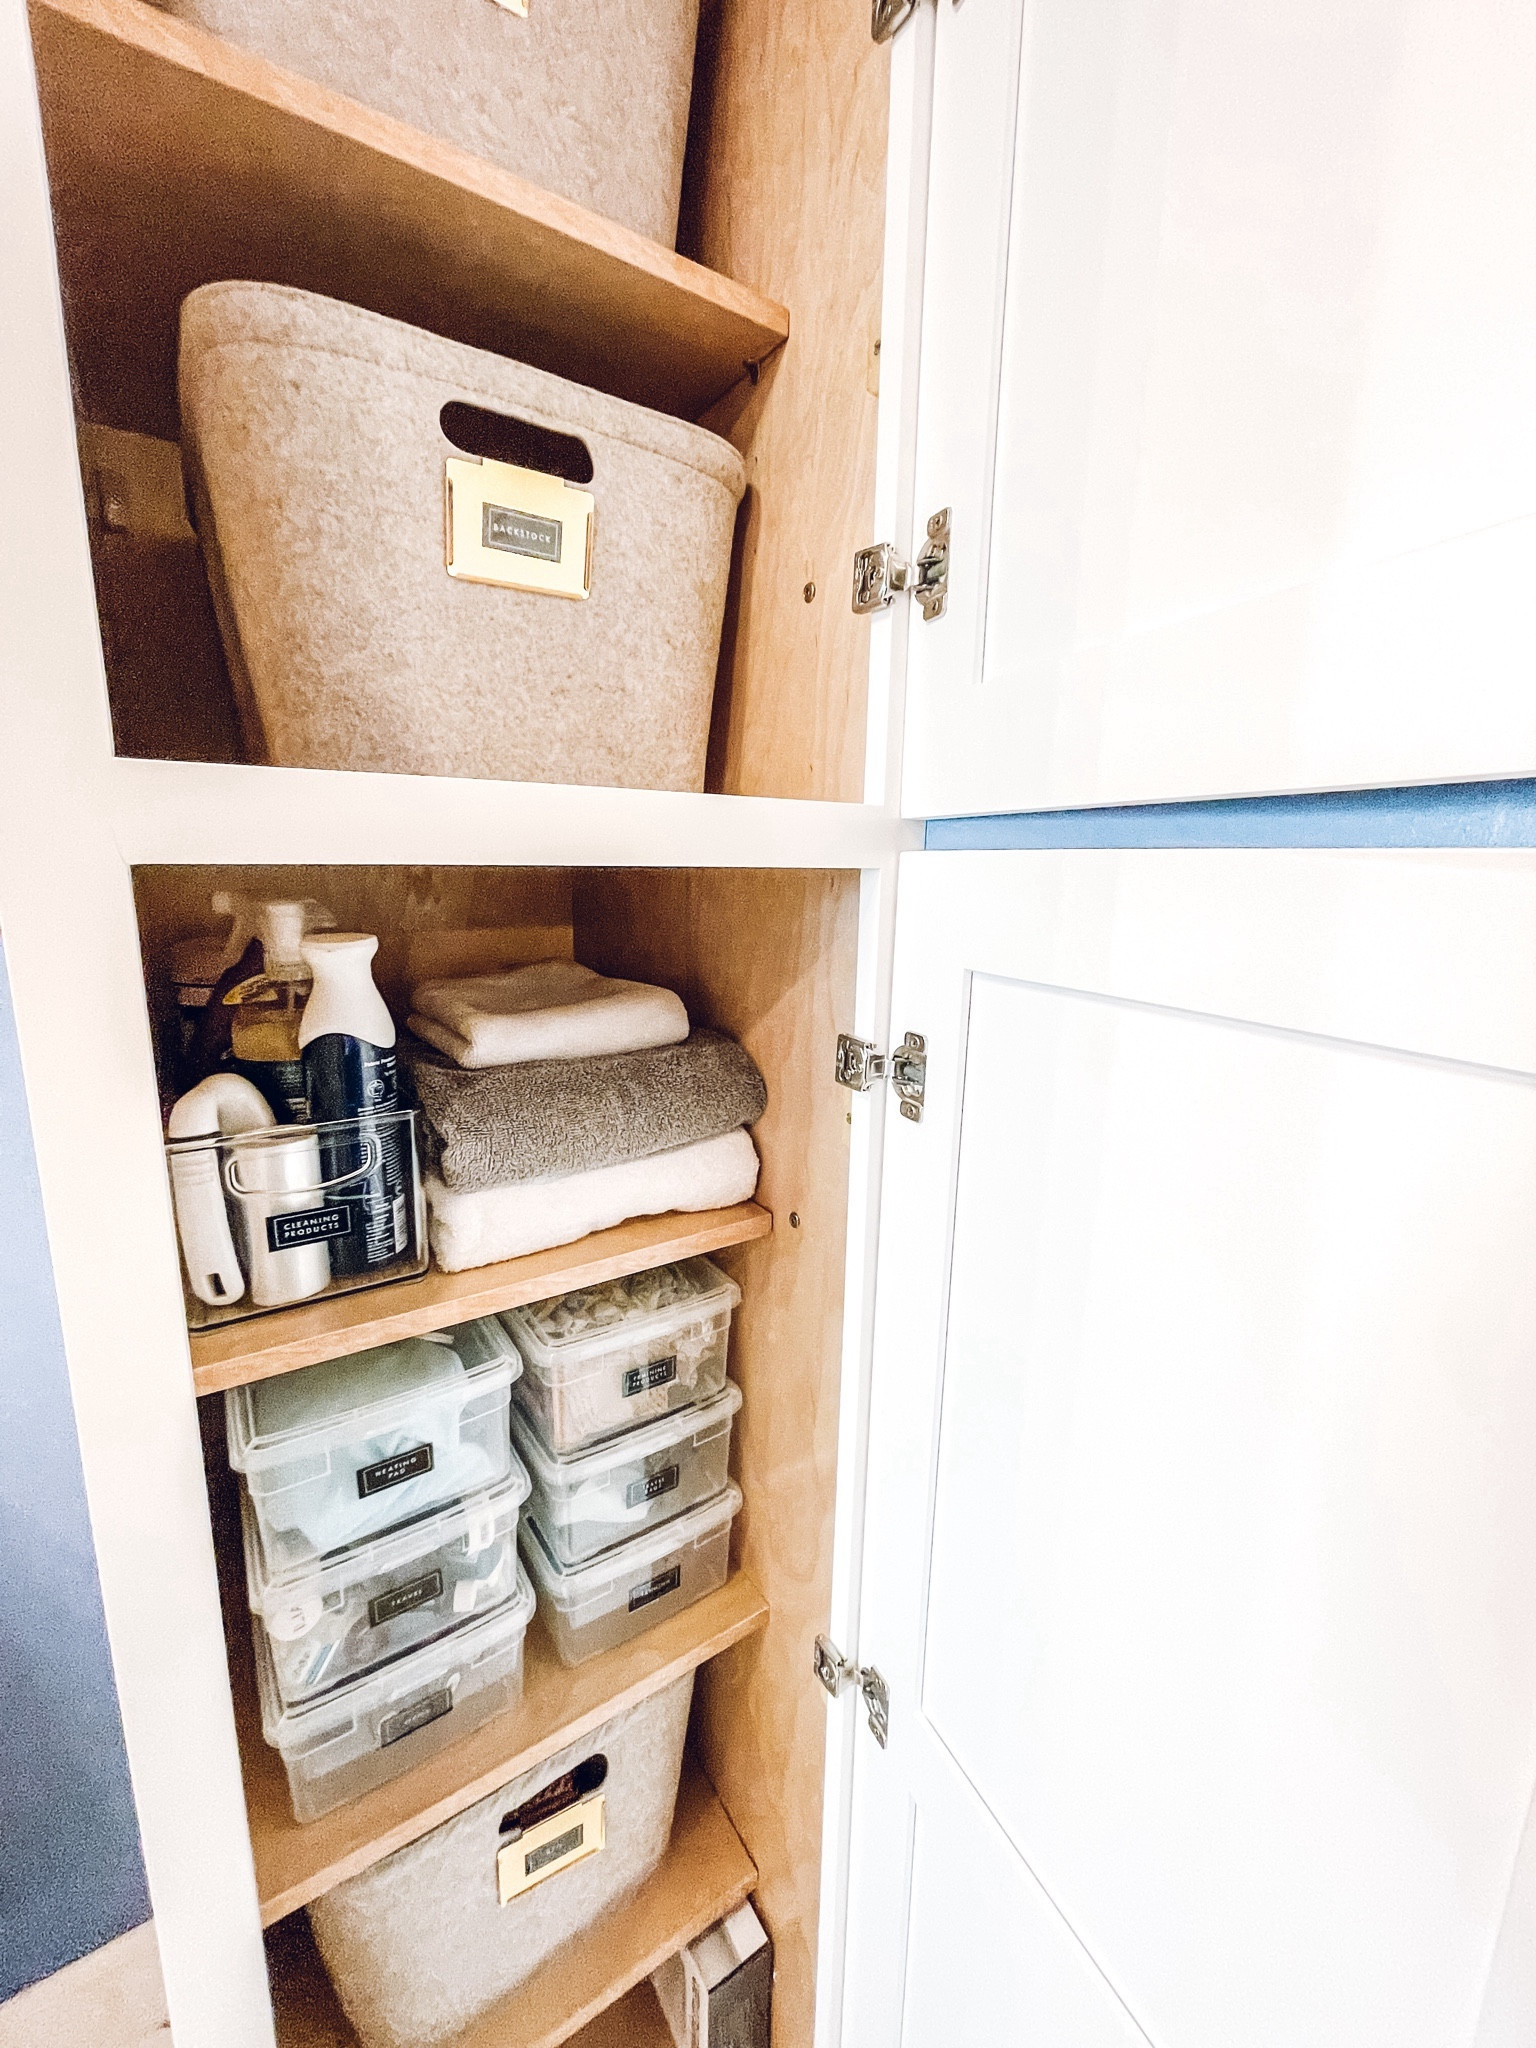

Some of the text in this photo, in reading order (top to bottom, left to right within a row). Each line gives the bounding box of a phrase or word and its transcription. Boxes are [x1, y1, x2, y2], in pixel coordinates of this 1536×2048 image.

[493, 522, 552, 544] BACKSTOCK
[283, 1213, 339, 1231] CLEANING
[284, 1221, 340, 1239] PRODUCTS
